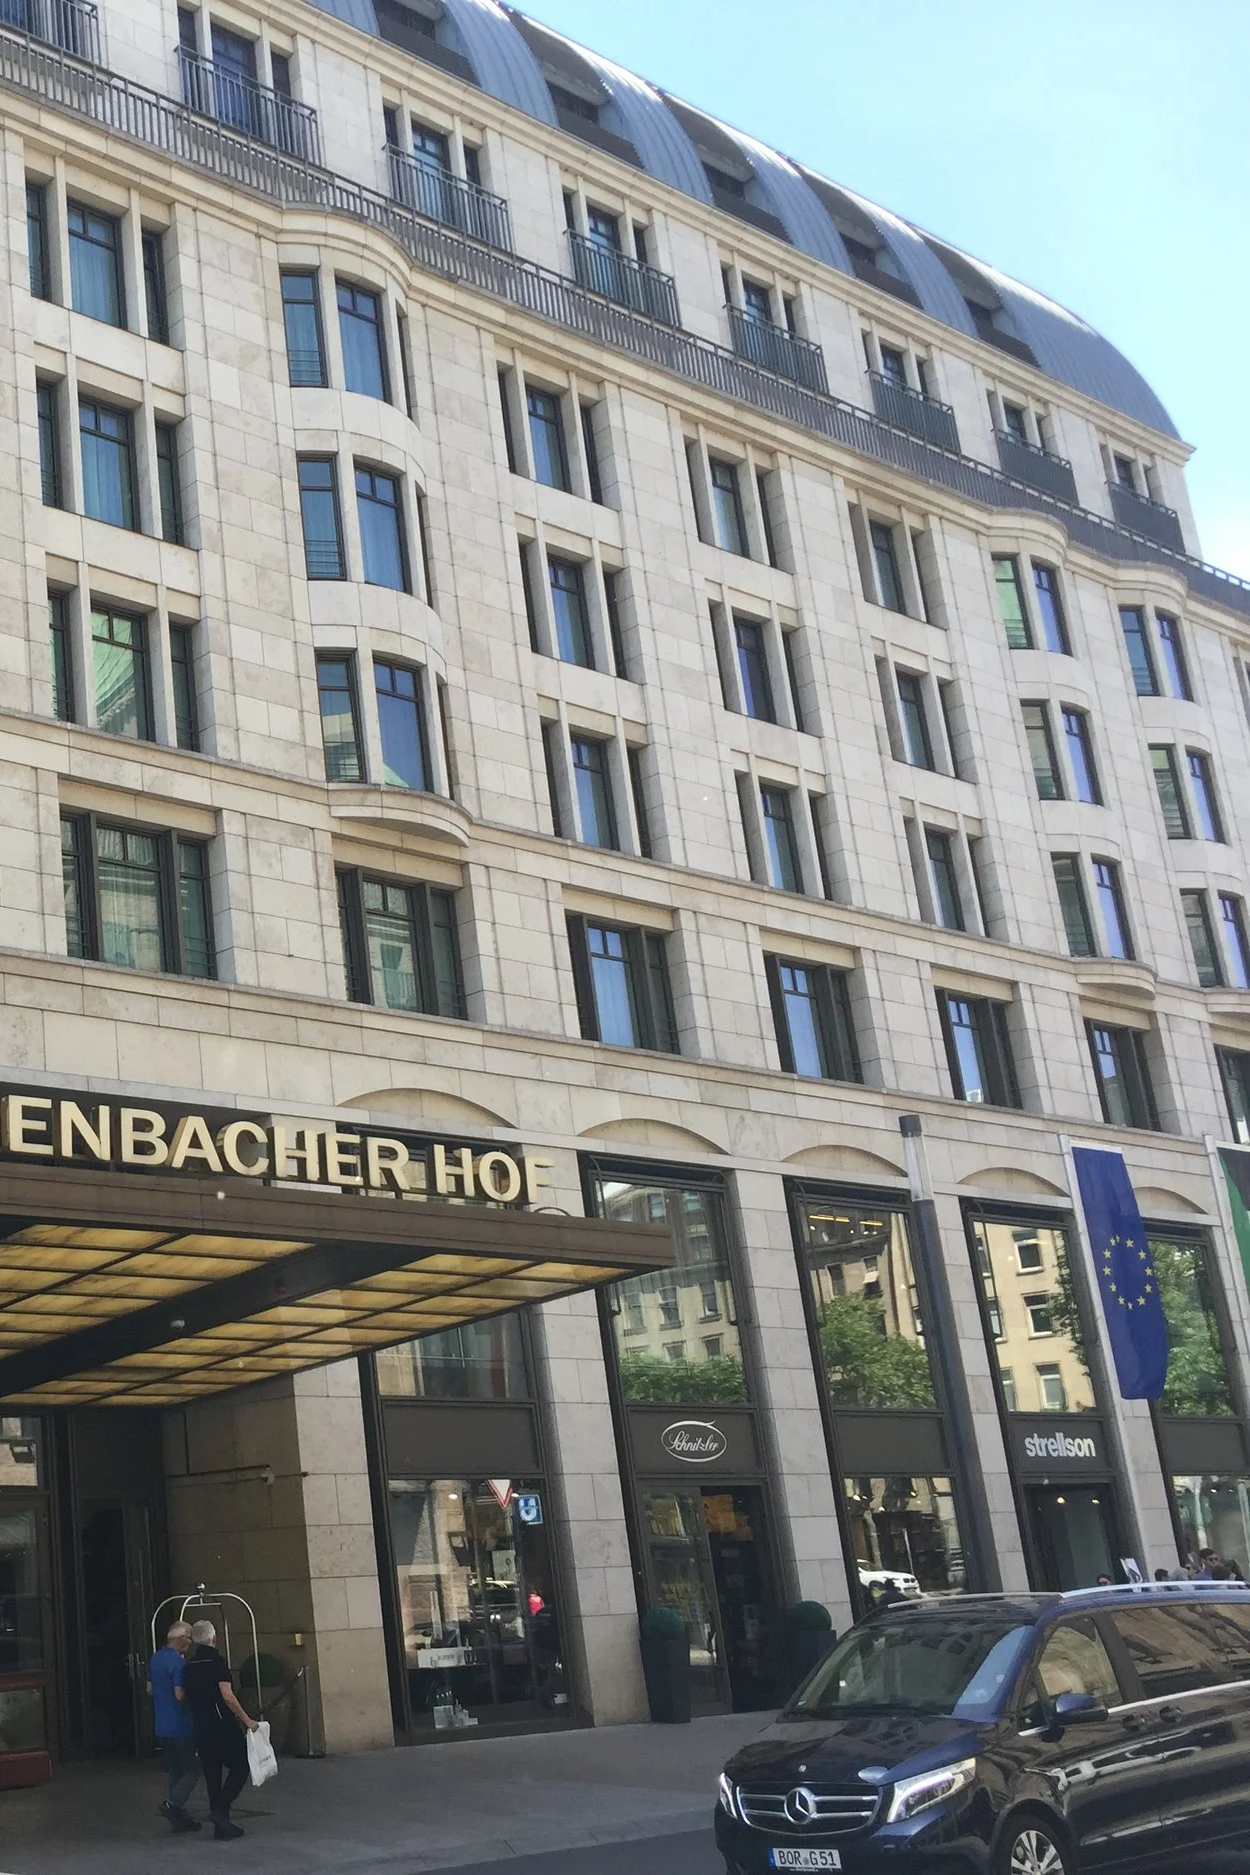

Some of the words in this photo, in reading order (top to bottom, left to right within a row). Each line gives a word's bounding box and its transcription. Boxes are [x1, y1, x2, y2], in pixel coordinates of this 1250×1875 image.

[432, 1143, 555, 1204] HOF
[667, 1430, 719, 1452] Schnitzler
[1024, 1432, 1097, 1457] strellson
[778, 1850, 802, 1866] BOR
